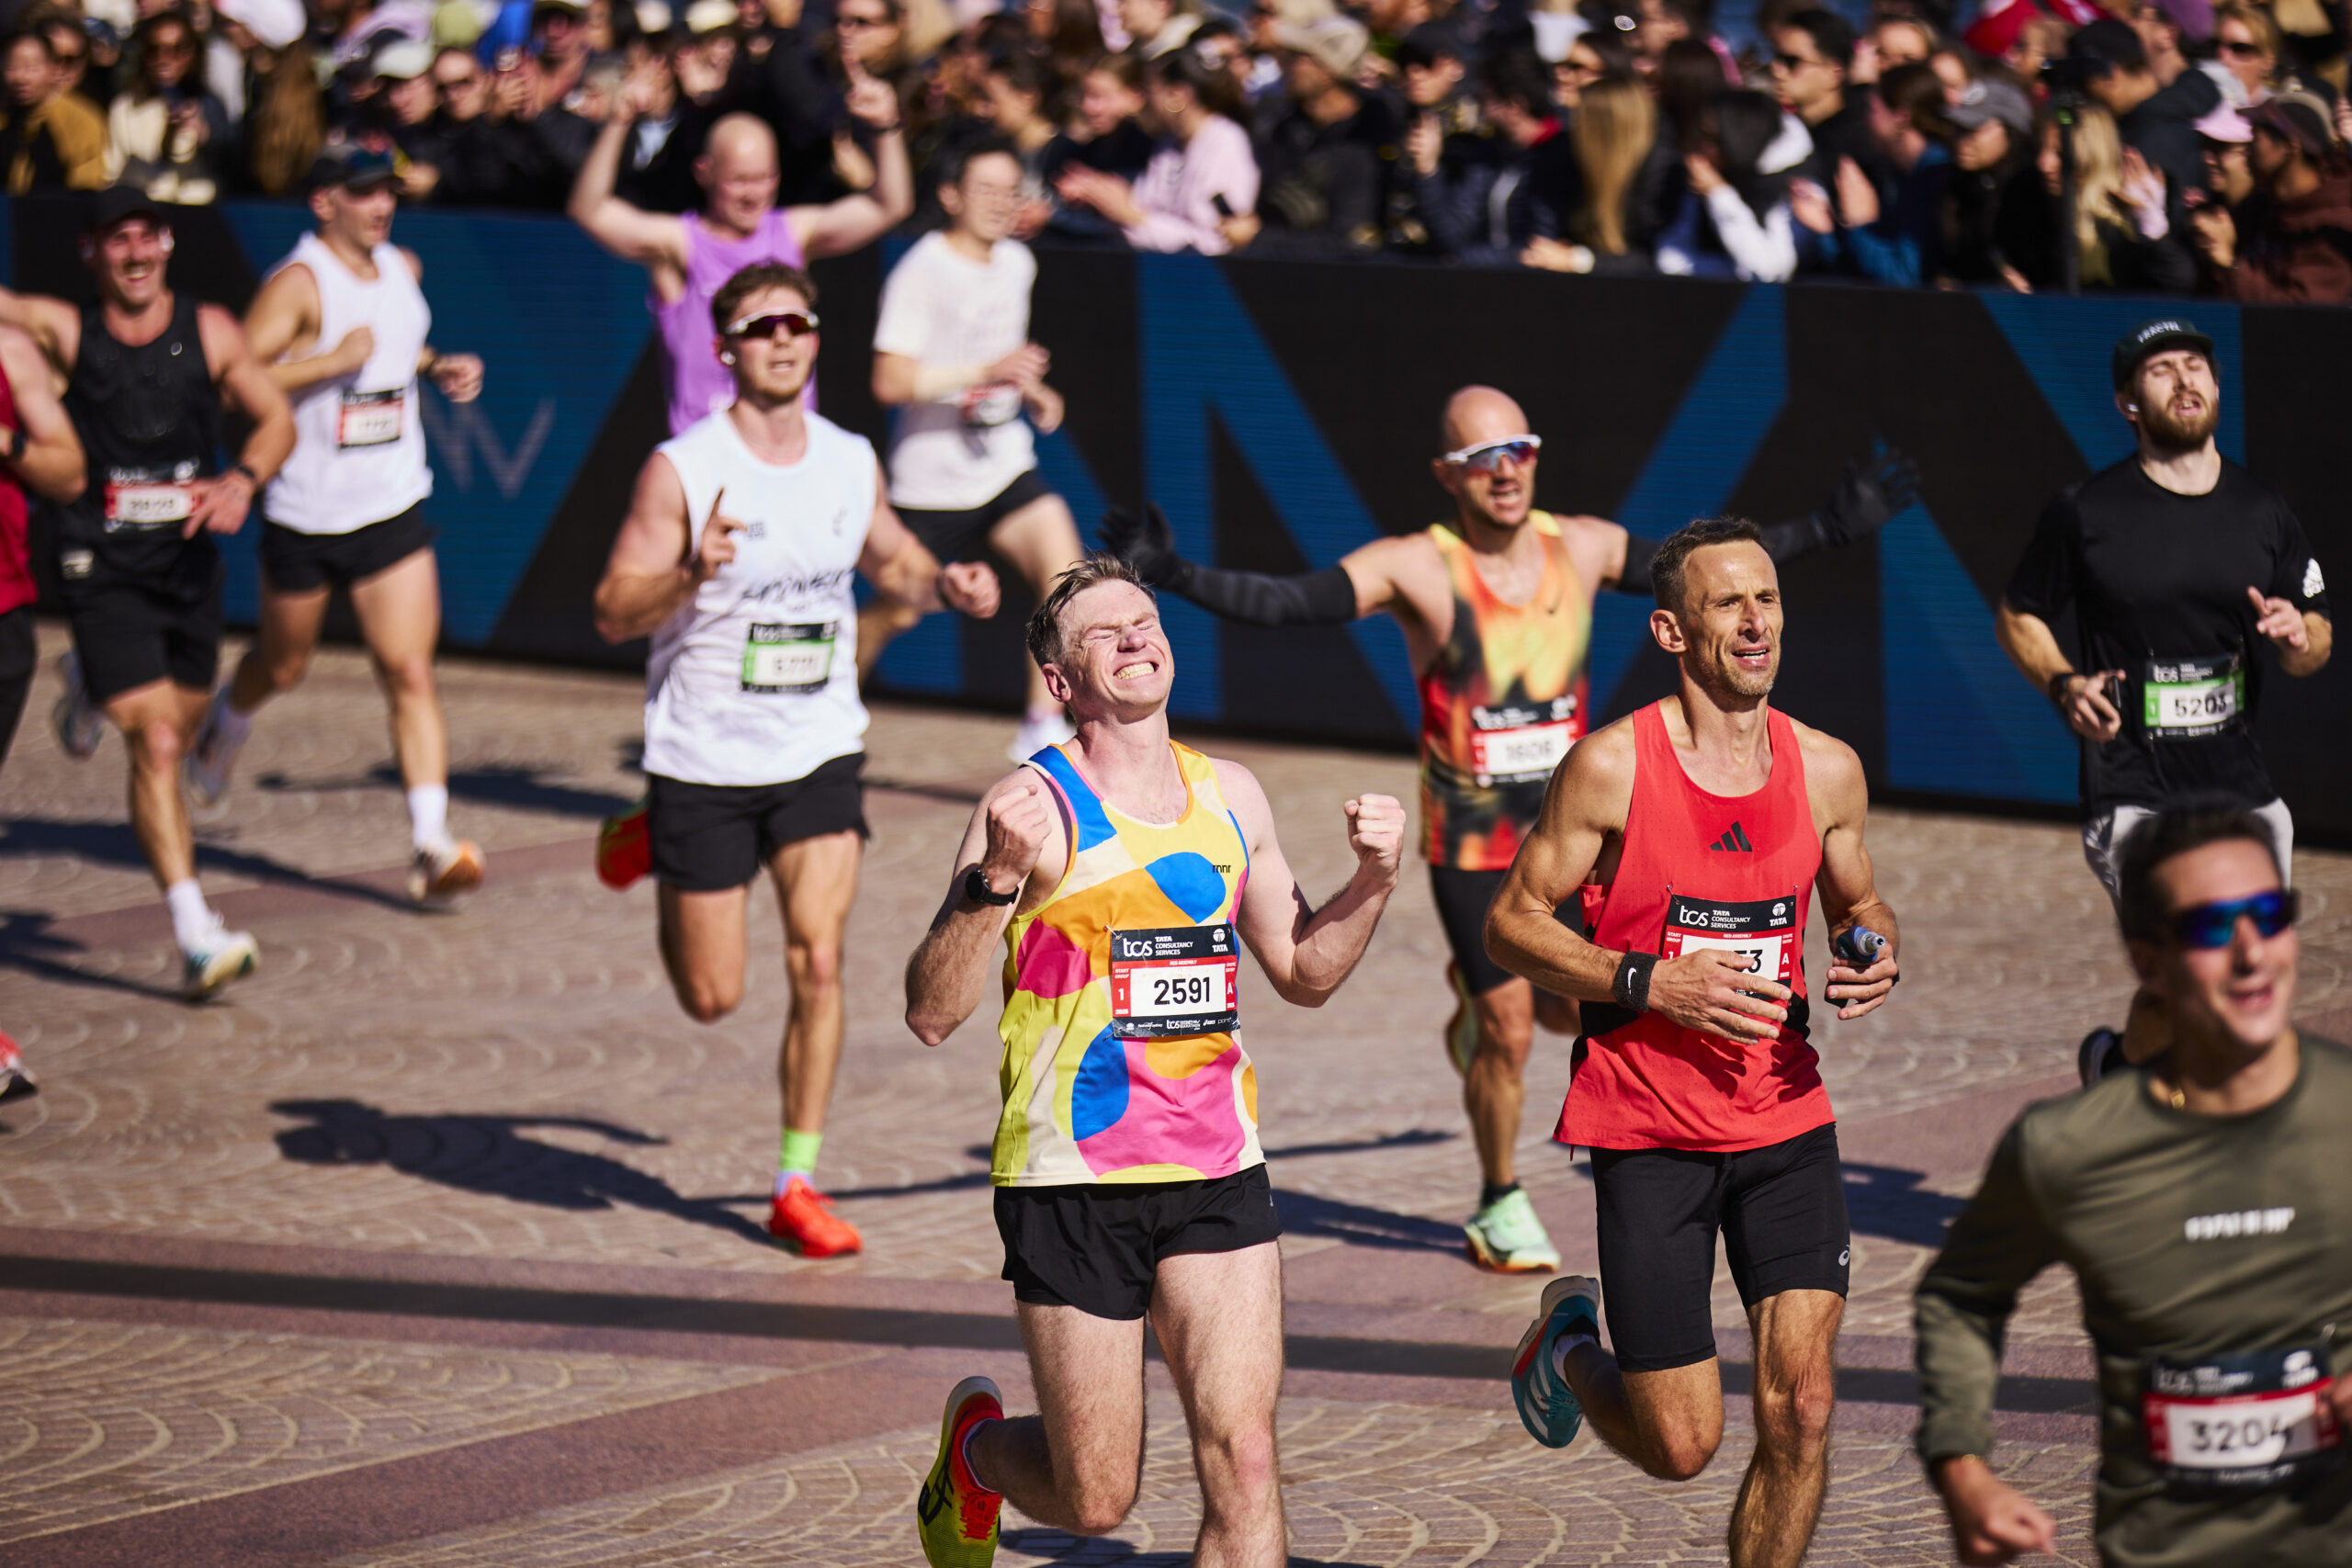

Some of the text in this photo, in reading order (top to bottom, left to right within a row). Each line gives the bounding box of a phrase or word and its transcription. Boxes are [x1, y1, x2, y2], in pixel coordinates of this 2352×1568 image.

[2154, 663, 2178, 682] tcs
[1212, 864, 1231, 873] rnnr
[1679, 905, 1709, 927] tcs
[1770, 917, 1787, 927] TATA
[1123, 938, 1153, 957] tcs
[1155, 941, 1193, 950] CONSULTANCY
[1212, 944, 1228, 953] TATA
[1781, 953, 1790, 964] A
[1118, 988, 1125, 1001] 1
[1153, 976, 1210, 1006] 2591
[1227, 982, 1234, 995] A
[1166, 1020, 1180, 1029] tcs
